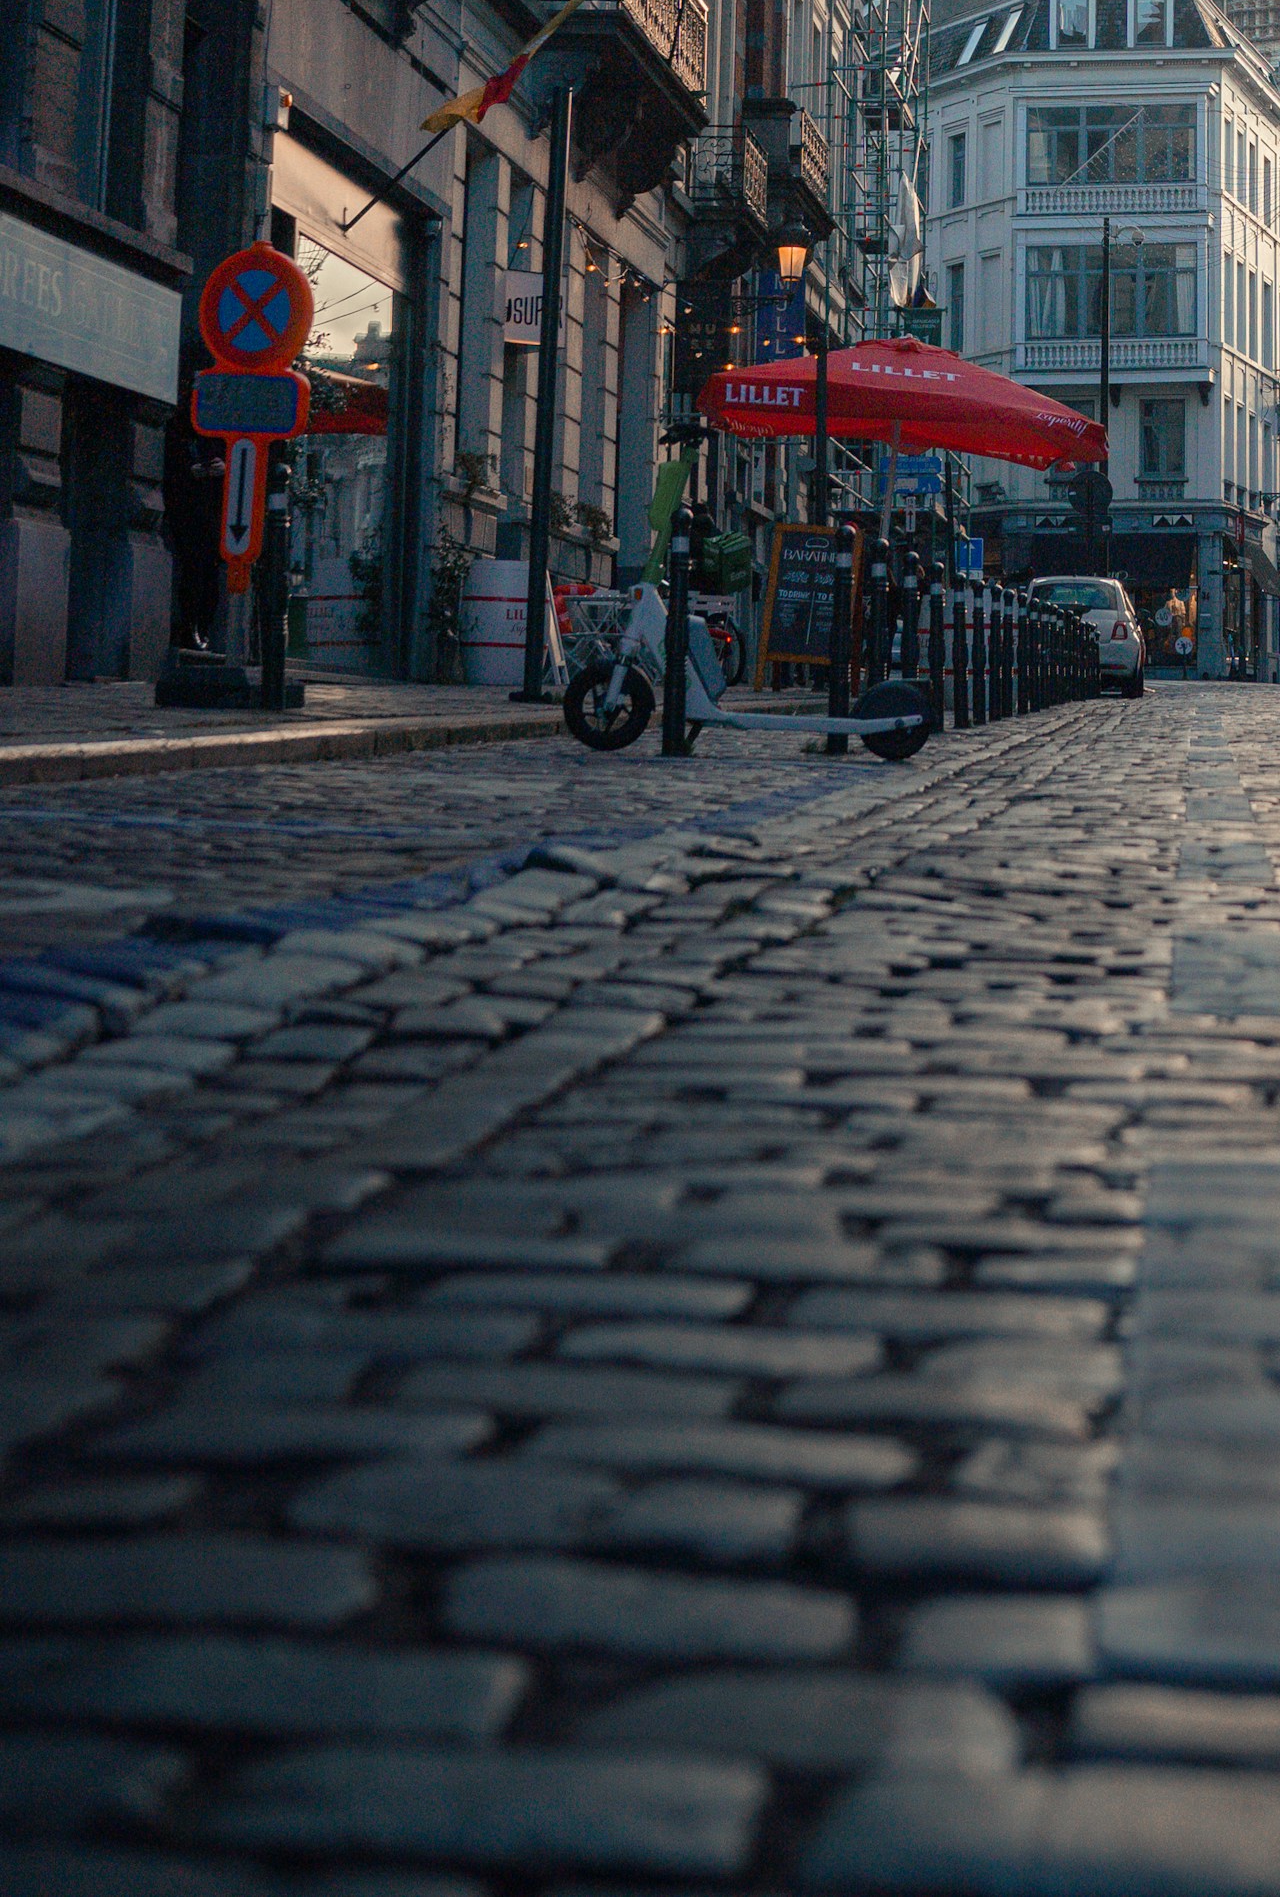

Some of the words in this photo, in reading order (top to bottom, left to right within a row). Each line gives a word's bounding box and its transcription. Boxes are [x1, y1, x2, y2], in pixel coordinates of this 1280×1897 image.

[0, 243, 62, 317] REES
[513, 295, 563, 329] SUP
[851, 361, 964, 382] LILLET
[724, 383, 808, 407] LILLET
